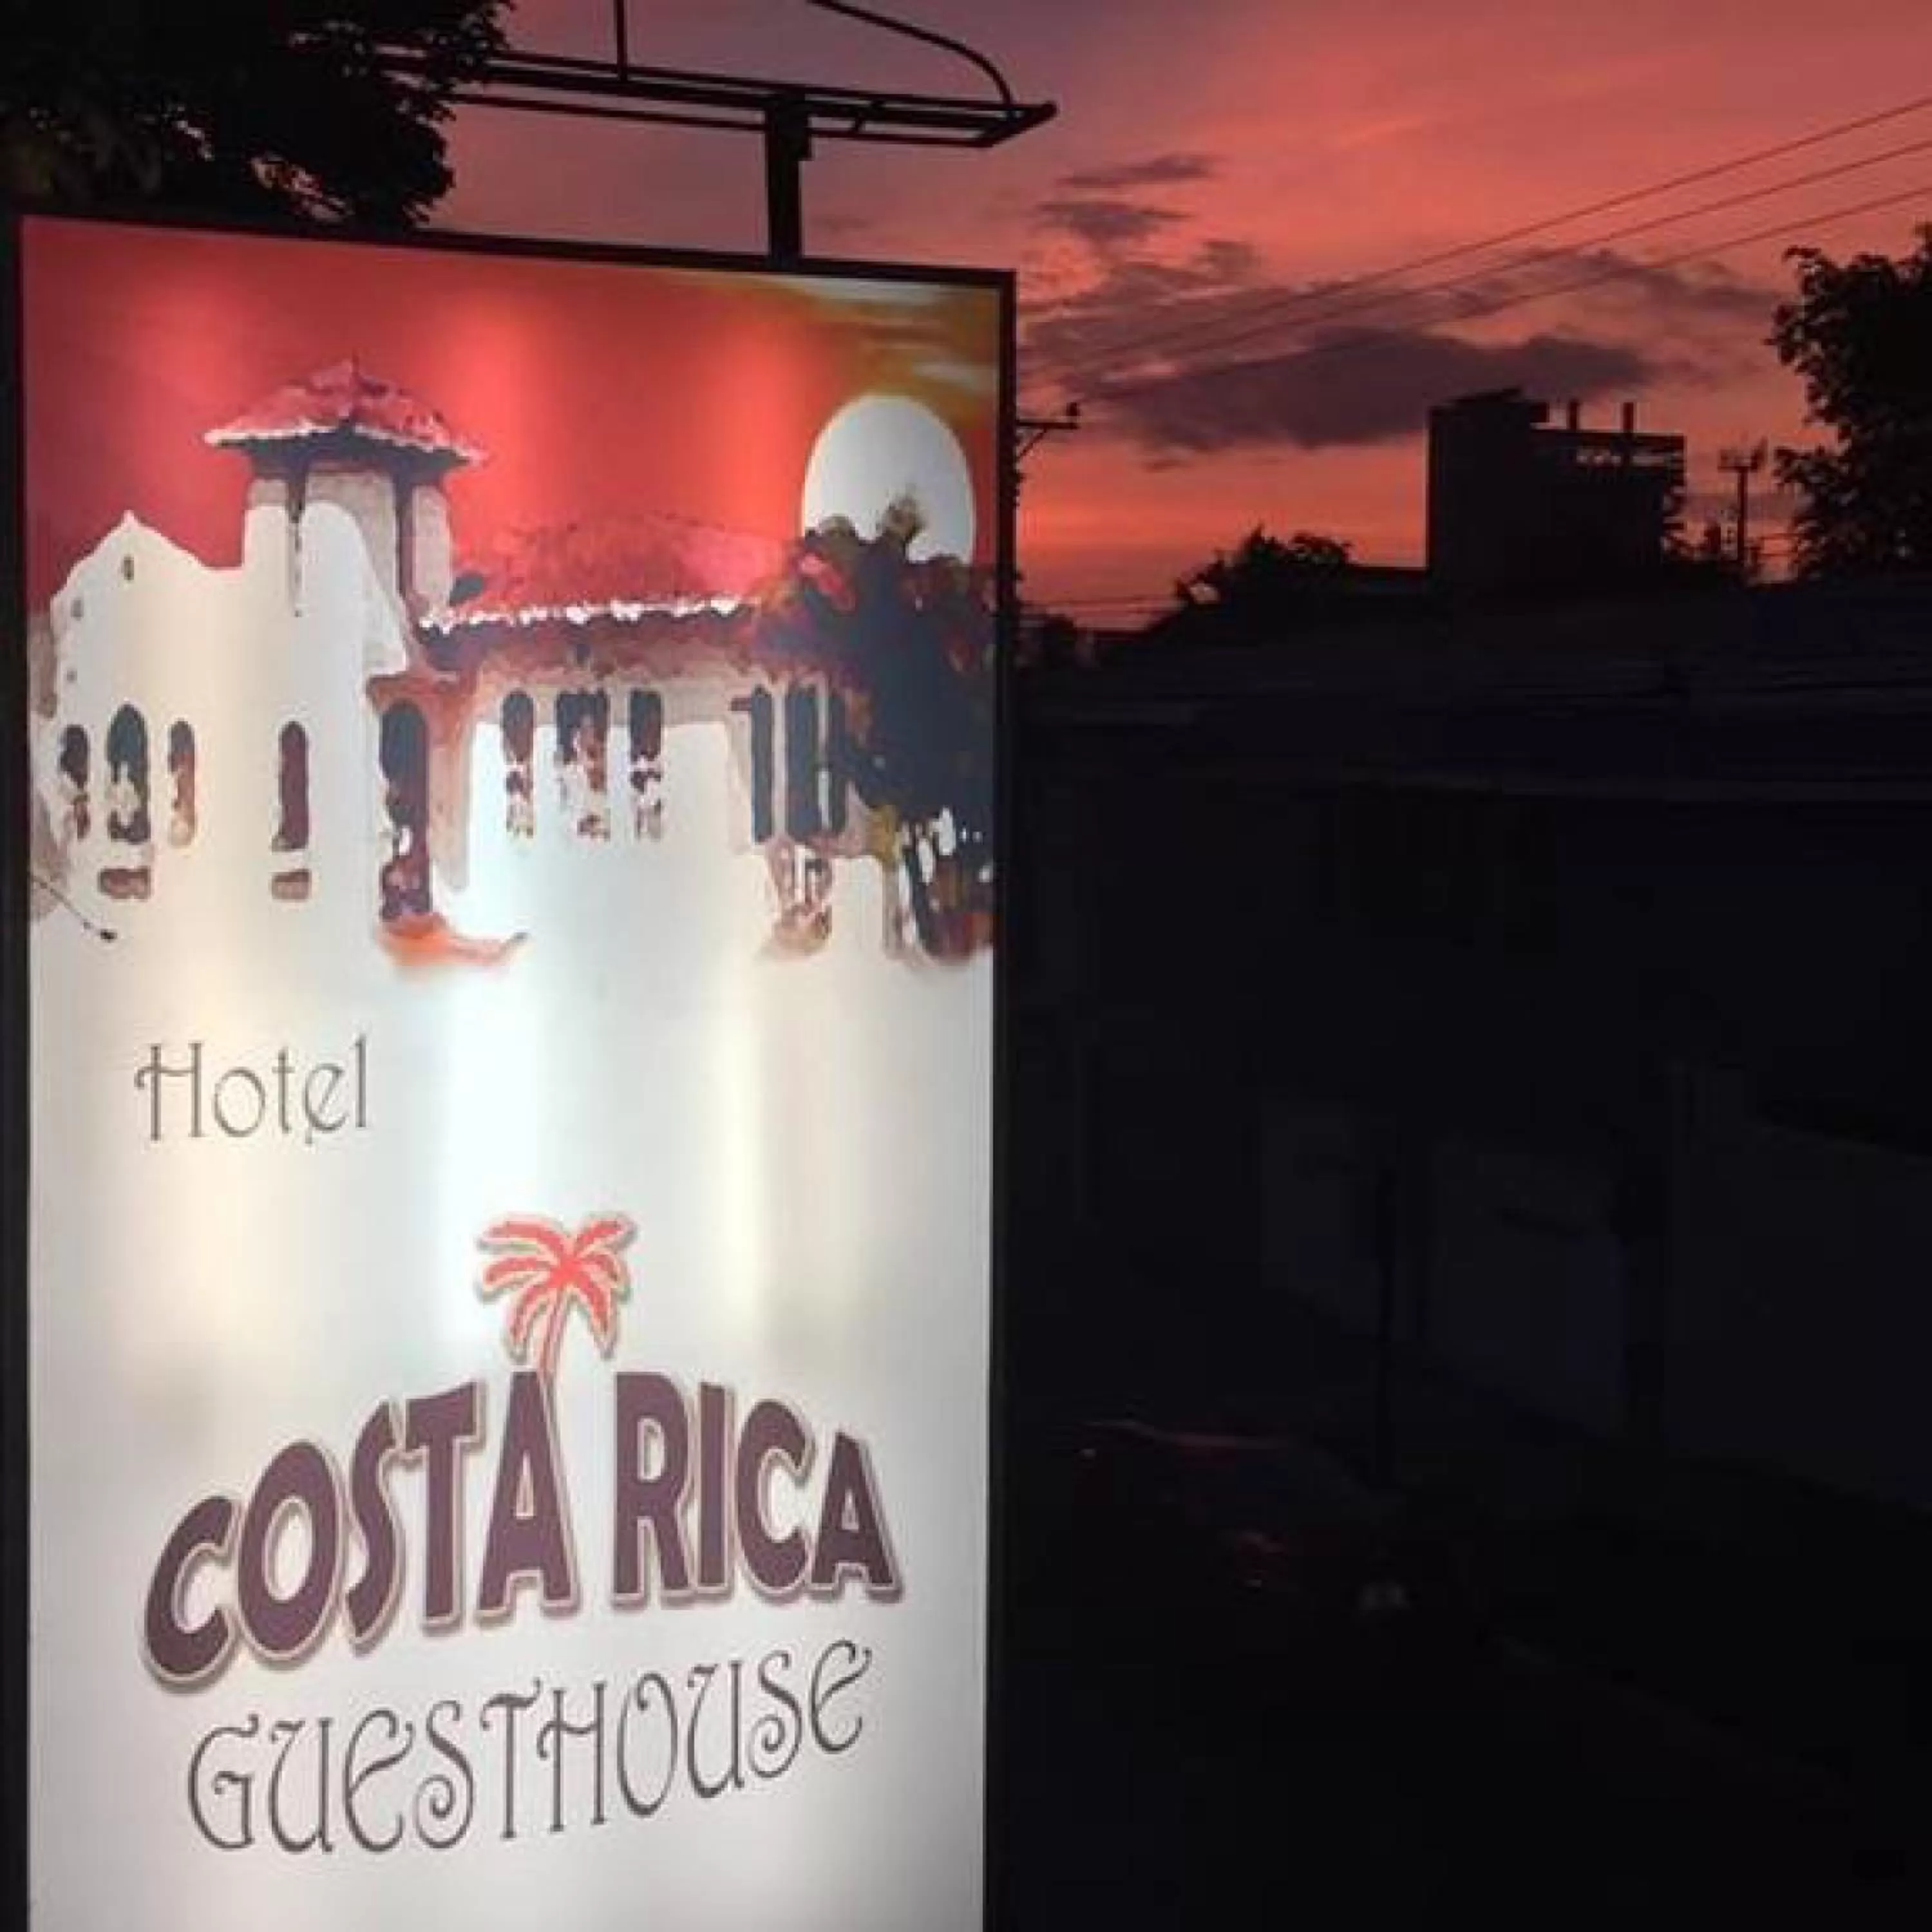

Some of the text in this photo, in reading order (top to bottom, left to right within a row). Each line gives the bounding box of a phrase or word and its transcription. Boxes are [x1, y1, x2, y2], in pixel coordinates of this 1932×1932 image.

[134, 1034, 367, 1144] Hotel
[143, 1369, 902, 1689] COSTA RICA
[187, 1638, 873, 1855] GUESTHOUSE
